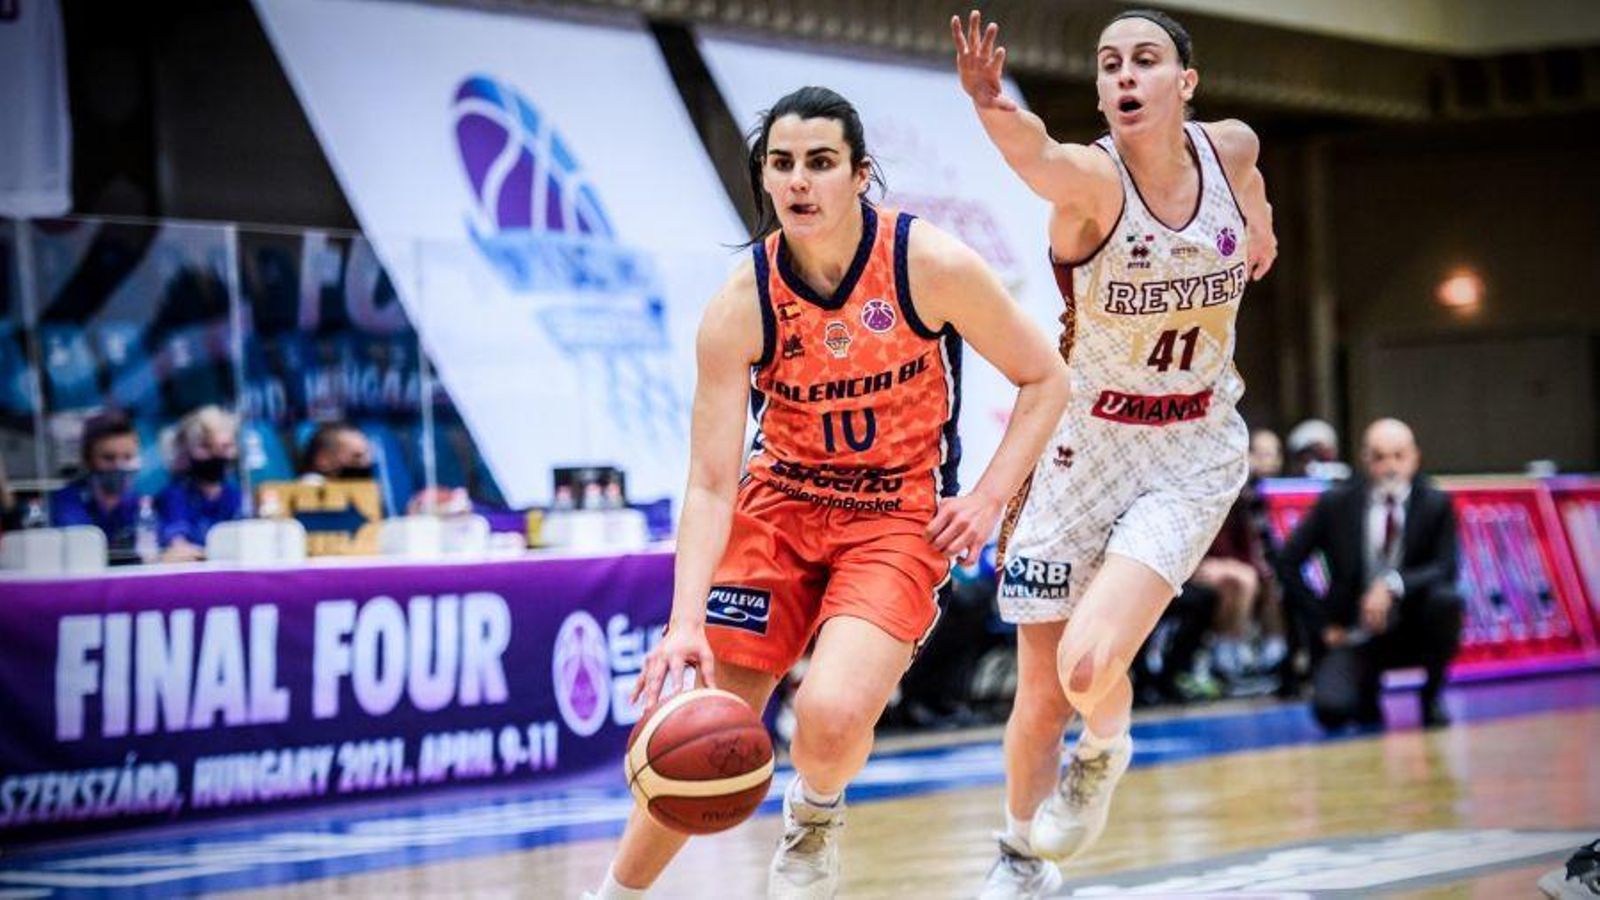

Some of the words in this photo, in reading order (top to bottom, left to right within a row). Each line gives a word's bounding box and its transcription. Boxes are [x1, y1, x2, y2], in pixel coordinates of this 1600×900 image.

[1146, 326, 1200, 372] 41
[822, 407, 876, 452] 10
[708, 590, 766, 609] PULEVA
[56, 606, 289, 740] FINAL
[312, 591, 513, 720] FOUR
[190, 743, 336, 808] HUNGARY
[417, 727, 498, 784] APRIL
[498, 719, 560, 775] 9-11
